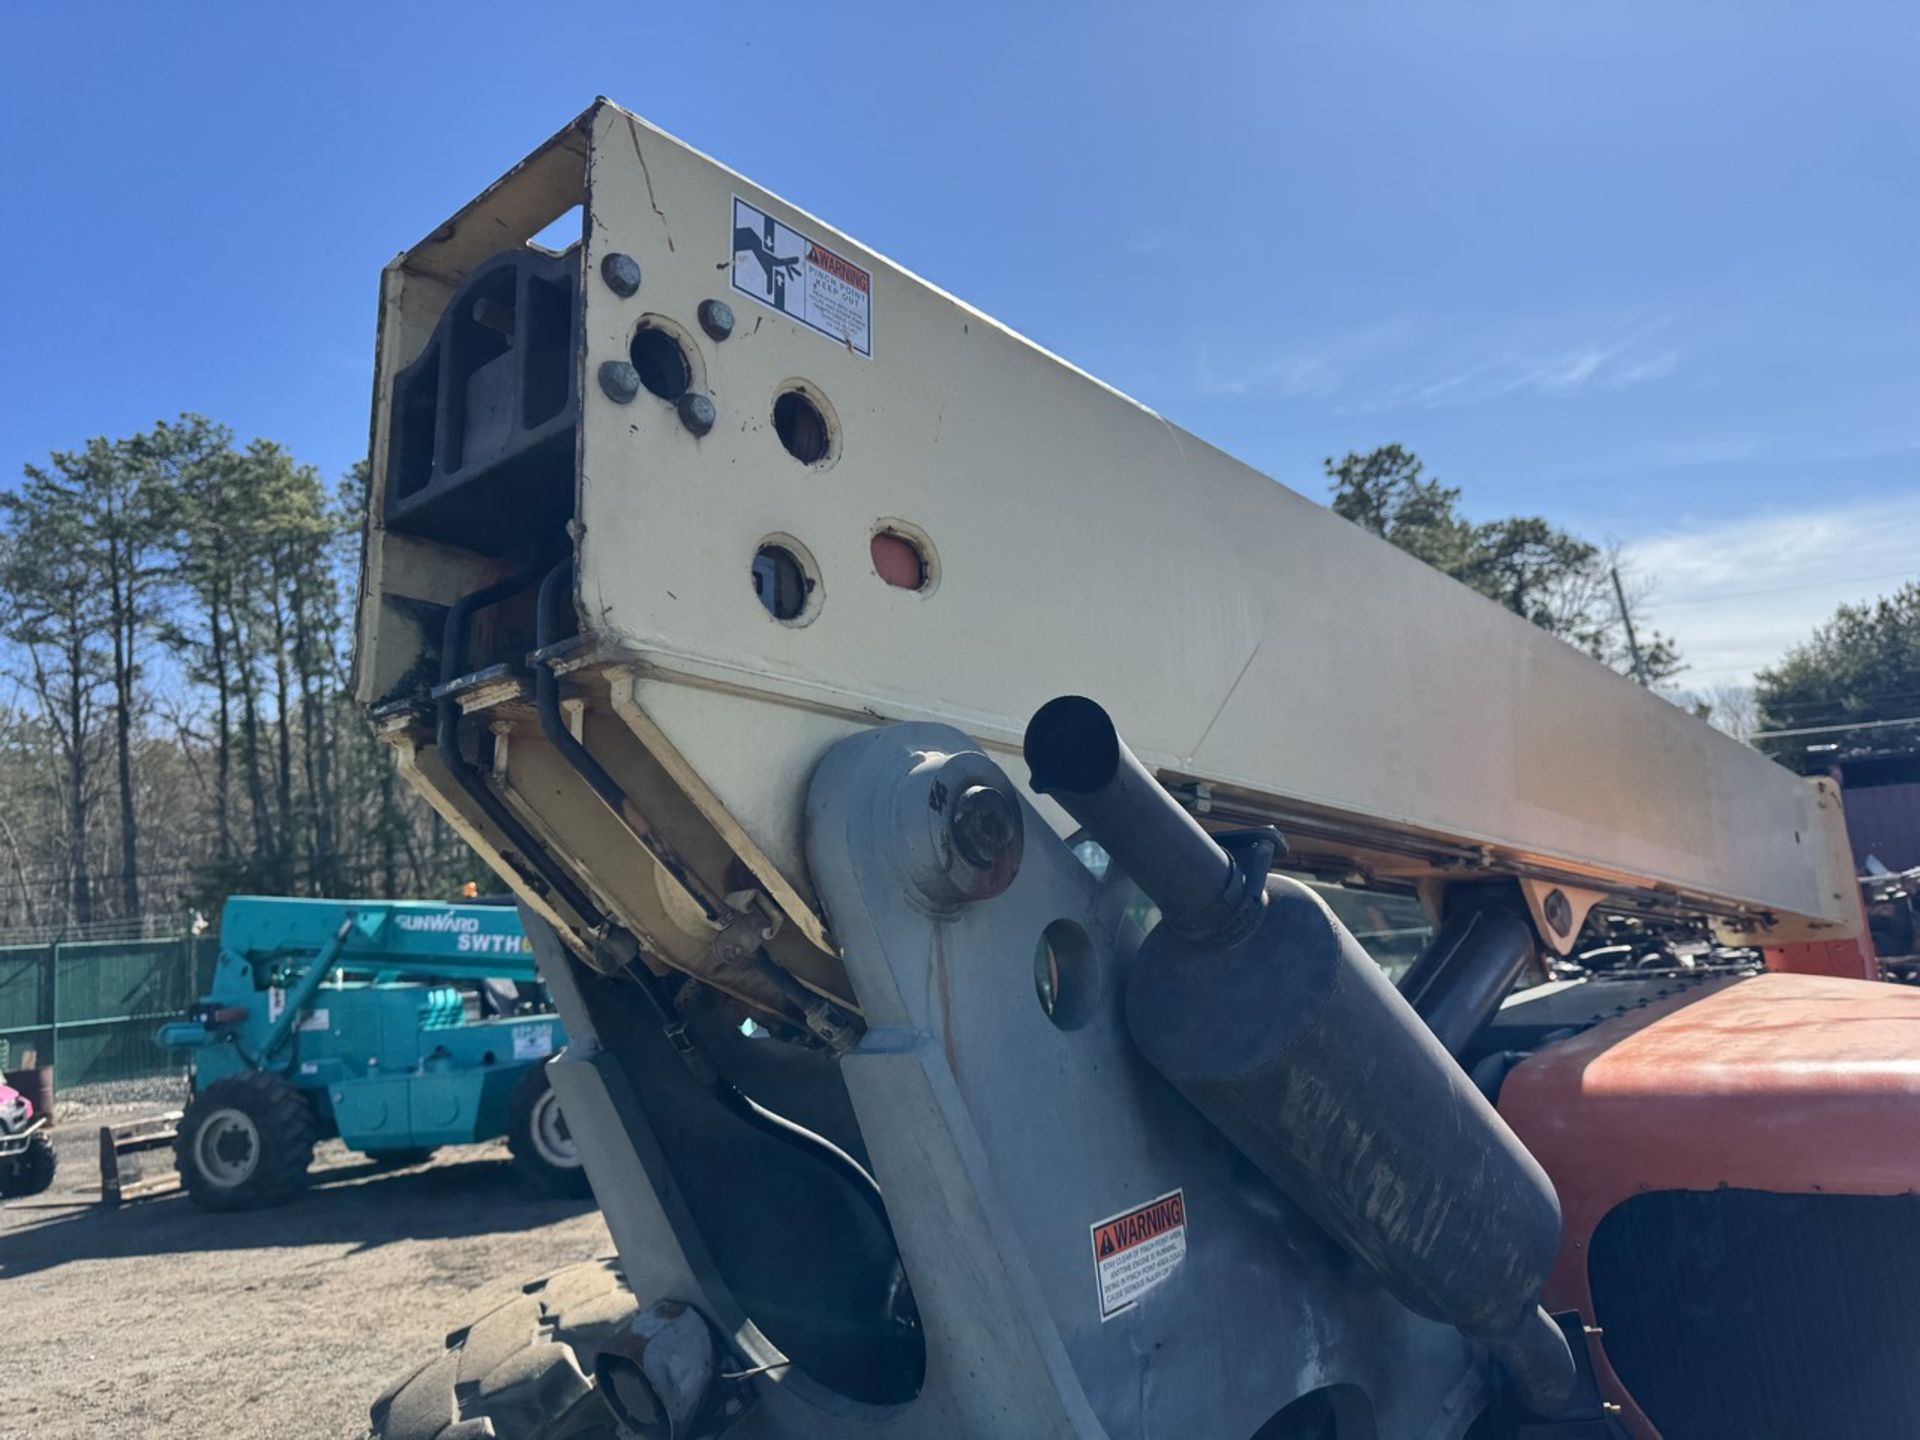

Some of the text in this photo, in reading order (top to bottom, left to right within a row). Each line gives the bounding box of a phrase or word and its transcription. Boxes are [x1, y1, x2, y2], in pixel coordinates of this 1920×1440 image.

[808, 265, 865, 302] PINCH POINT
[819, 250, 865, 290] WARNING
[815, 278, 838, 294] KEEP
[842, 292, 859, 307] OUT
[395, 911, 479, 933] SUNWARD
[1113, 1199, 1181, 1248] WARNING
